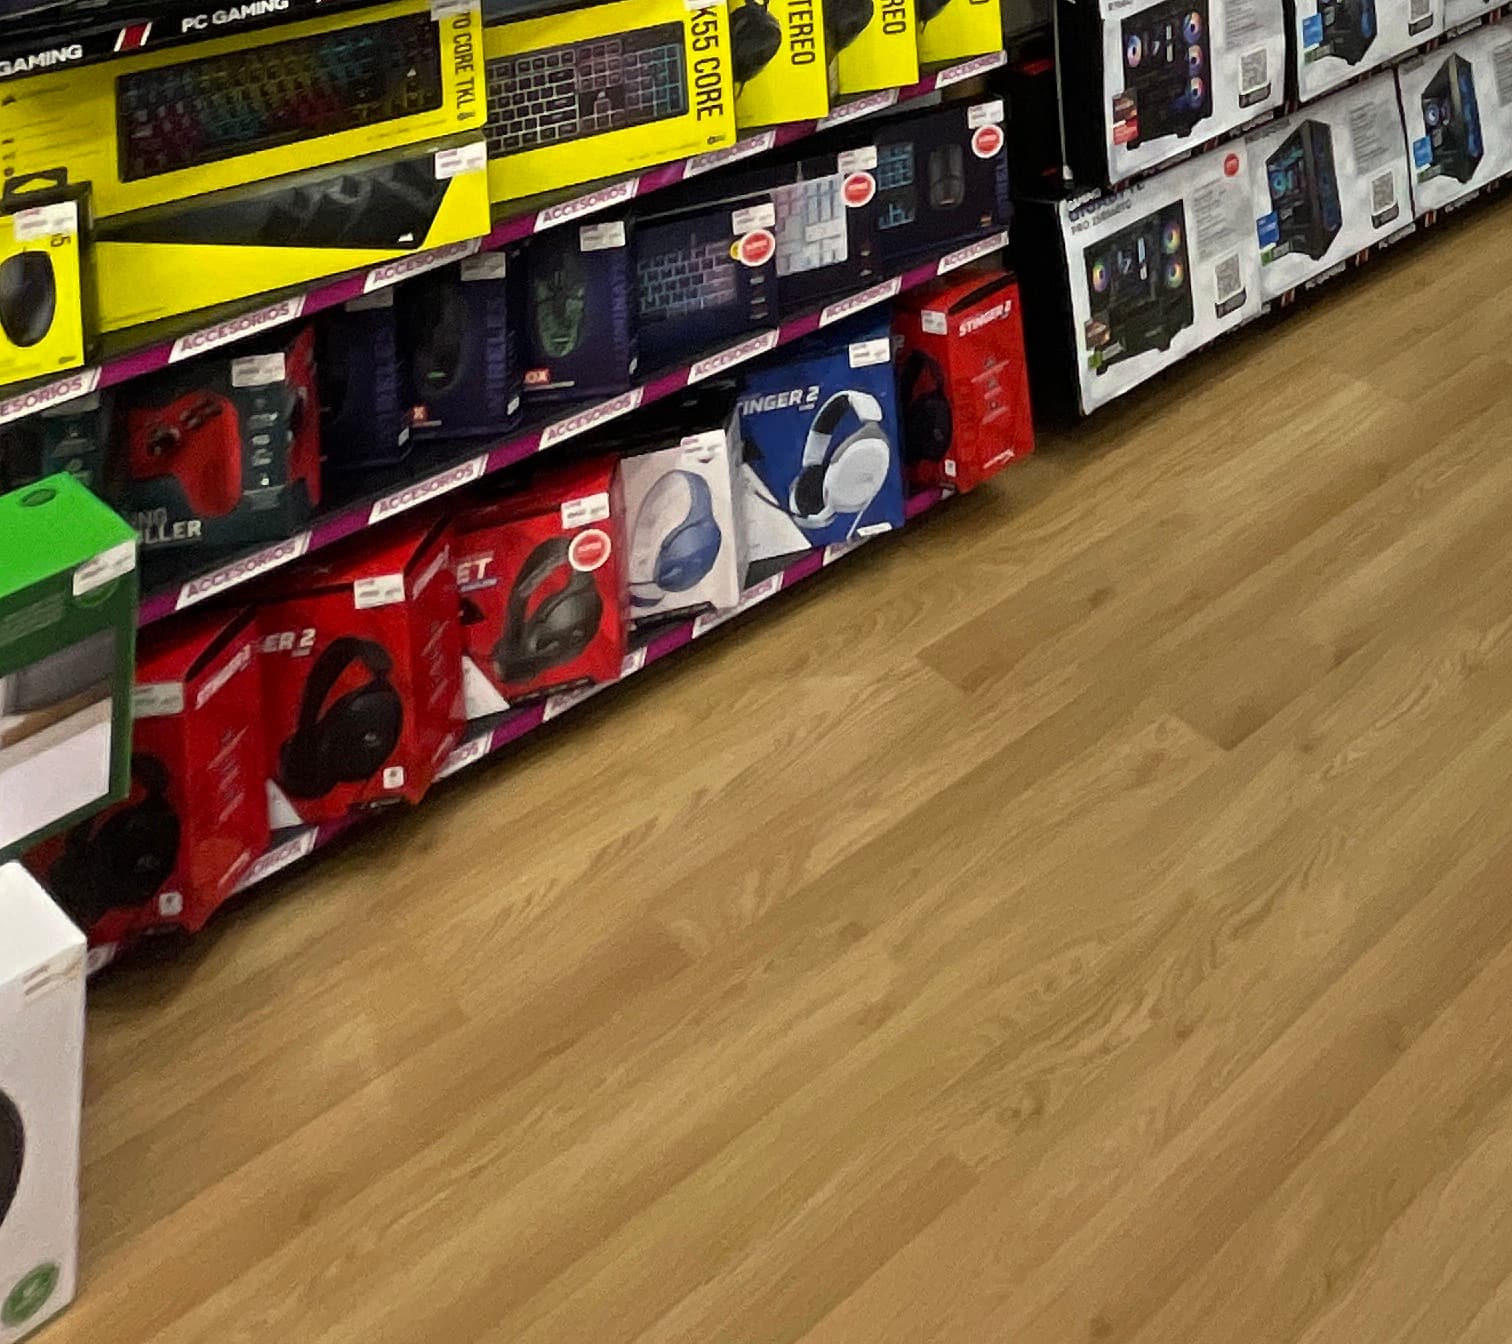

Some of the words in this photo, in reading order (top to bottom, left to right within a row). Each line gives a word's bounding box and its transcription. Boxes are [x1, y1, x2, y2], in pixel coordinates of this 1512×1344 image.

[182, 15, 208, 32] PC
[453, 33, 474, 75] CORE
[456, 77, 475, 109] TKL
[694, 58, 723, 120] CORE
[542, 184, 631, 224] ACCESORIOS
[180, 304, 290, 351] ACCESORIOS
[546, 397, 635, 442] ACCESORIOS
[377, 462, 475, 516] ACCESORIOS
